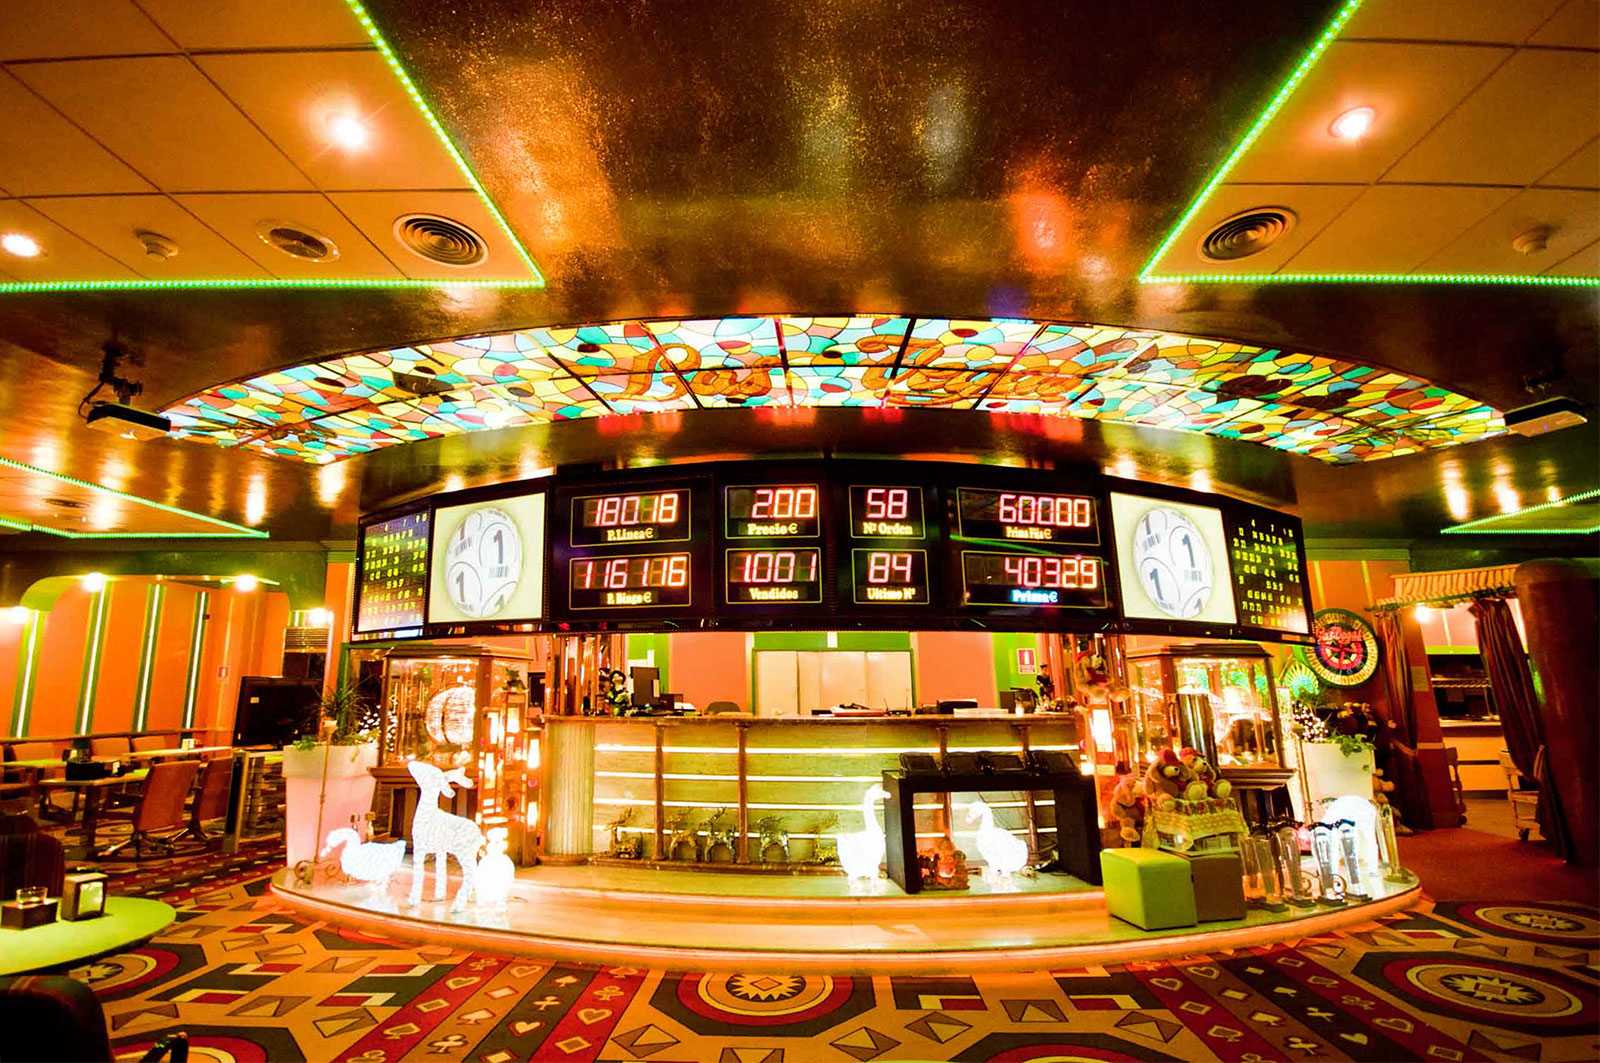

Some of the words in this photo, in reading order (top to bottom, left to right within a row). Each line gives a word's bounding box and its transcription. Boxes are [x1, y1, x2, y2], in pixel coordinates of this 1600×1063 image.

[866, 488, 909, 519] 58
[878, 522, 913, 535] Orden
[493, 530, 504, 564] 1
[1182, 534, 1195, 568] 1
[868, 552, 912, 583] 84
[456, 571, 466, 603] 1
[750, 588, 798, 600] Vendidos
[1150, 568, 1163, 601] 1
